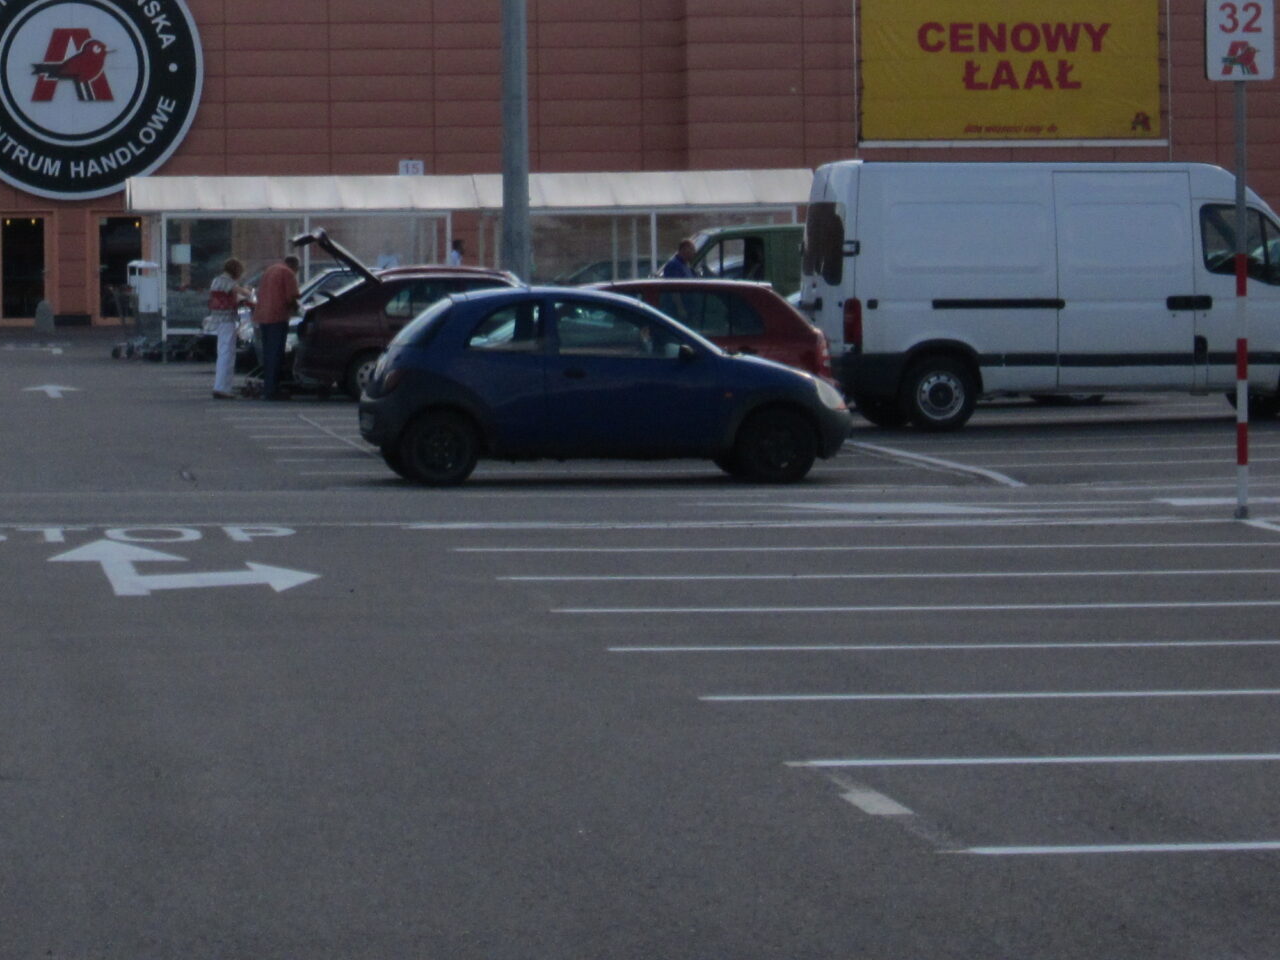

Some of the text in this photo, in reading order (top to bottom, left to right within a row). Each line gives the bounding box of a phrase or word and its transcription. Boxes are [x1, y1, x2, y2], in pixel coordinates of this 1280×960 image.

[1219, 2, 1262, 33] 32
[917, 22, 1112, 53] CENOWY
[962, 60, 1081, 90] ŁAAŁ
[70, 96, 176, 179] HANDLOWE
